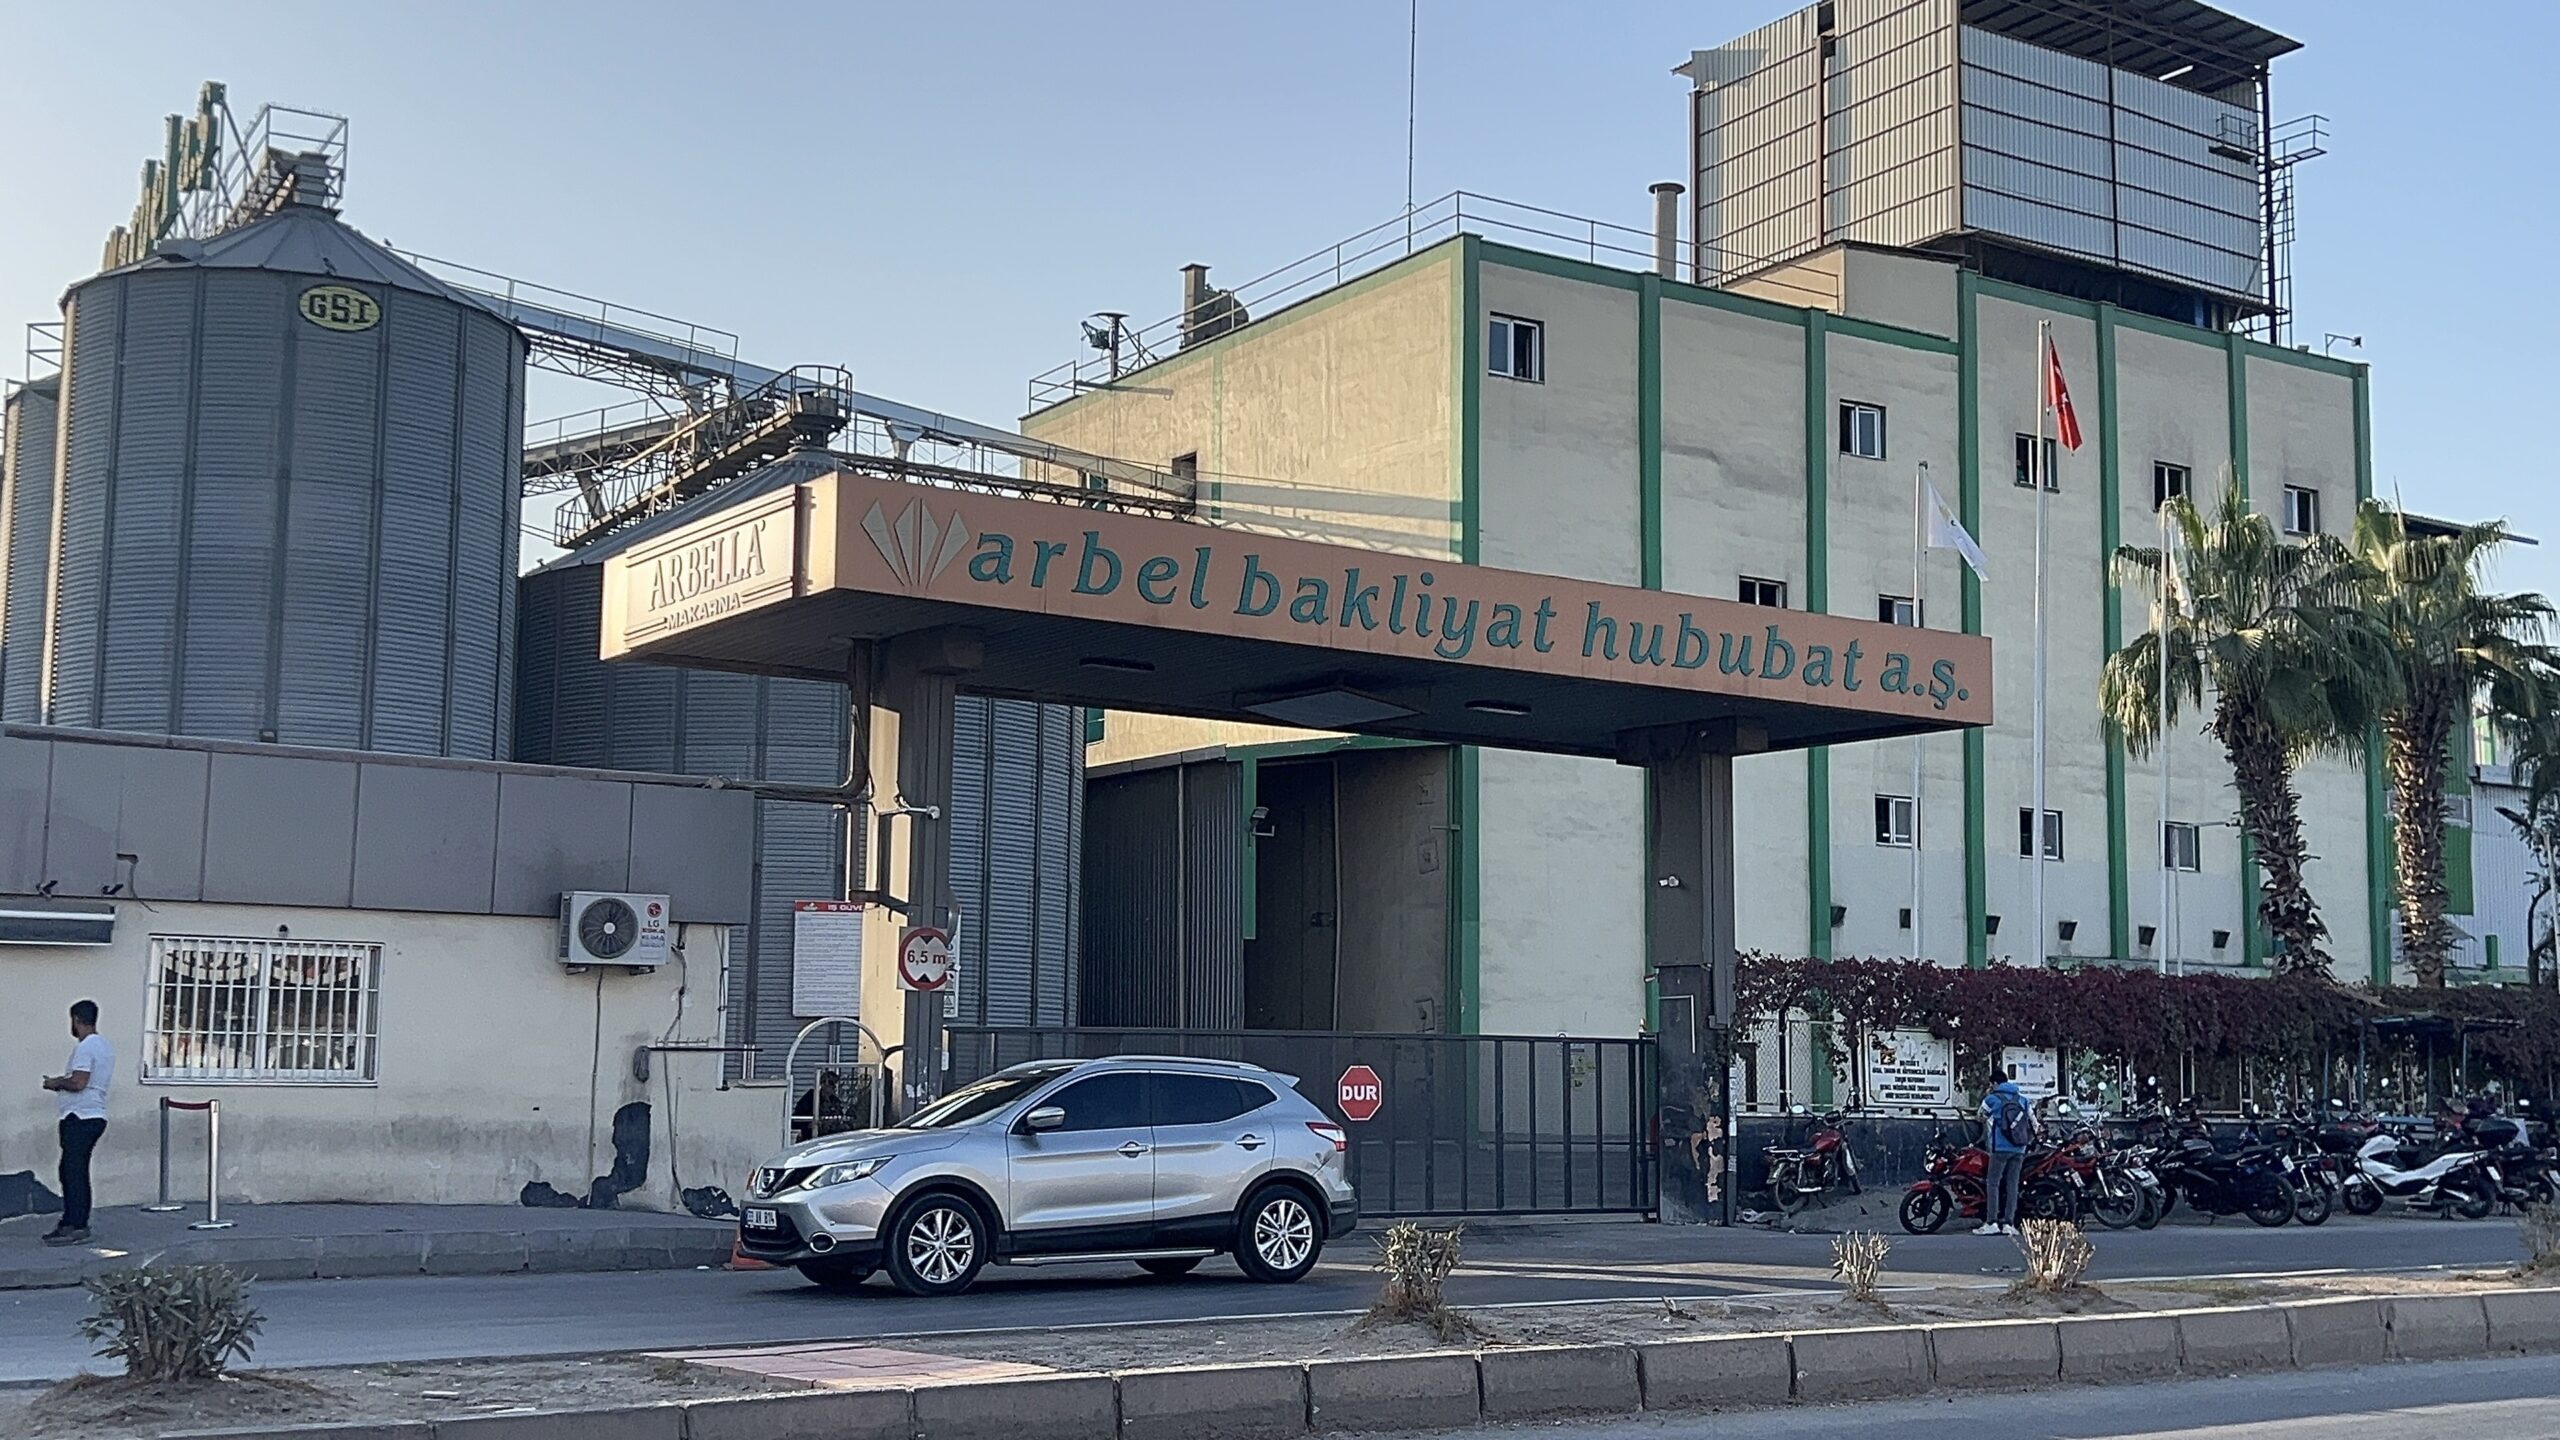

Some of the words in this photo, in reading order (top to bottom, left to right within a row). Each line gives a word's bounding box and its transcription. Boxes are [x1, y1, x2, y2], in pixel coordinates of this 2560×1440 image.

[309, 294, 370, 323] GSI
[667, 592, 742, 630] MAKARNA
[968, 531, 1212, 609] arbel
[1234, 554, 1557, 660] bakliyat
[1582, 601, 1864, 691] hububat
[1879, 649, 1970, 710] a.ş.
[647, 919, 660, 928] LG
[907, 950, 928, 965] 6,5
[932, 954, 946, 965] m
[1342, 1085, 1378, 1101] DUR
